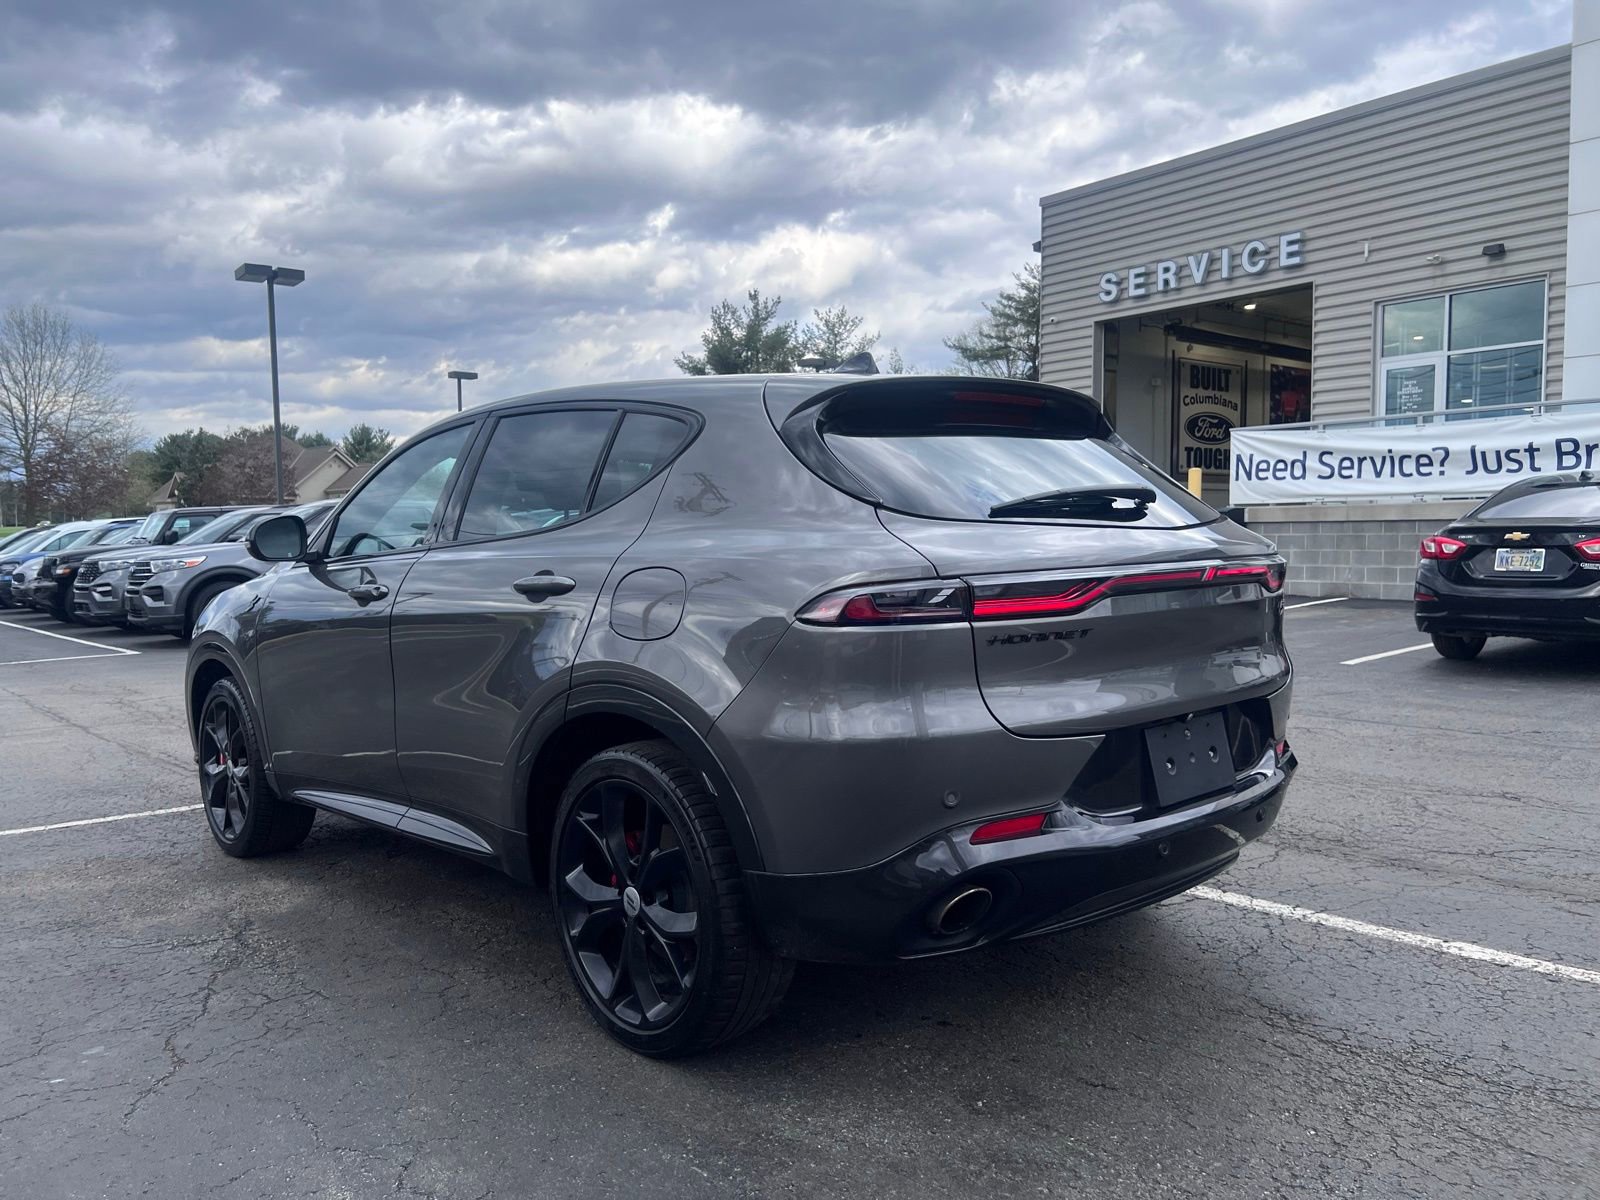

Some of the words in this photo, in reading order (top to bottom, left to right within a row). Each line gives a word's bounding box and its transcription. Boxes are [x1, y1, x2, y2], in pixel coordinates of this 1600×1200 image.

[1099, 231, 1303, 302] SERVICE
[1190, 365, 1231, 392] BUILT
[1183, 393, 1238, 412] Columbiana
[1195, 417, 1226, 439] Ford
[1235, 450, 1307, 482] Need
[1317, 446, 1450, 480] Service?
[1465, 441, 1541, 475] Just
[985, 628, 1093, 646] HORNET
